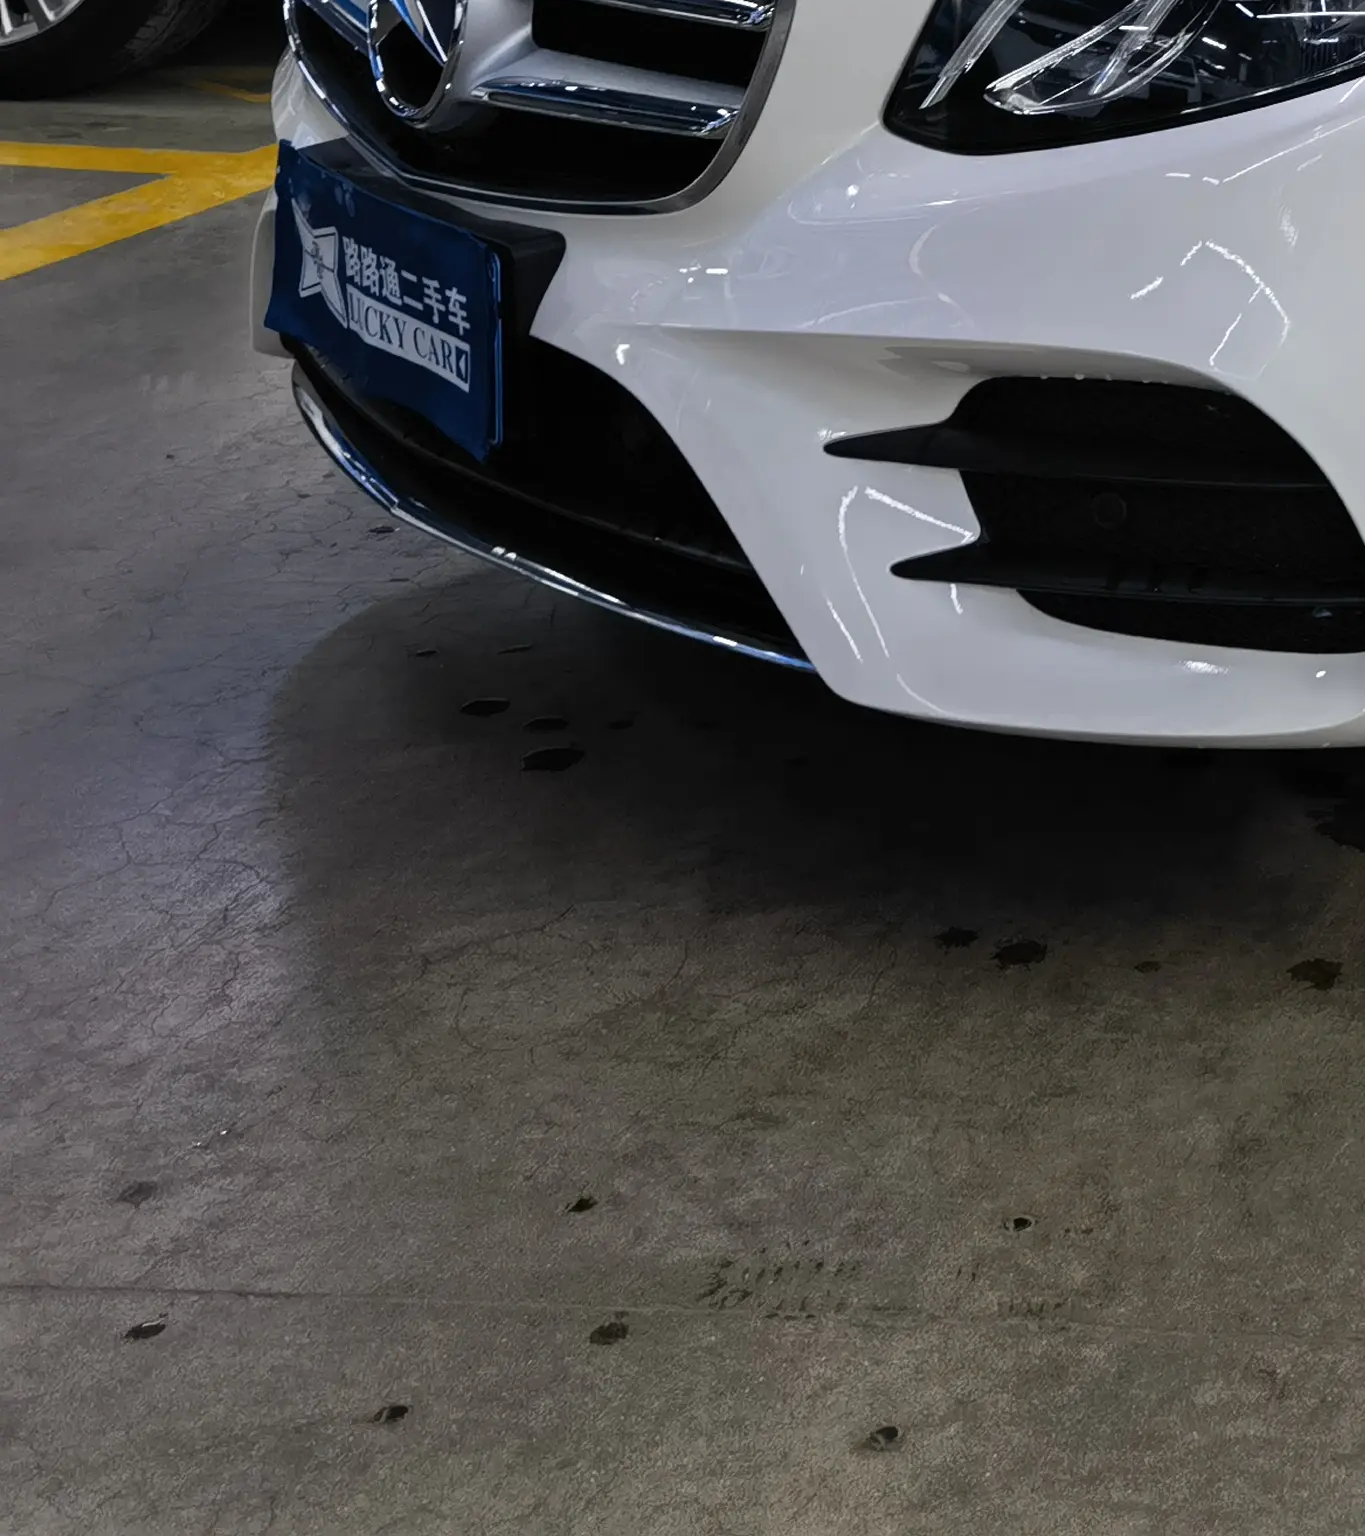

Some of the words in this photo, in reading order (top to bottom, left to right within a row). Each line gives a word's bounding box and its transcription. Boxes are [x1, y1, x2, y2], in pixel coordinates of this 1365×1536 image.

[342, 236, 471, 336] 路路通二手车
[350, 293, 407, 350] LUCKY
[413, 327, 455, 374] CAR
